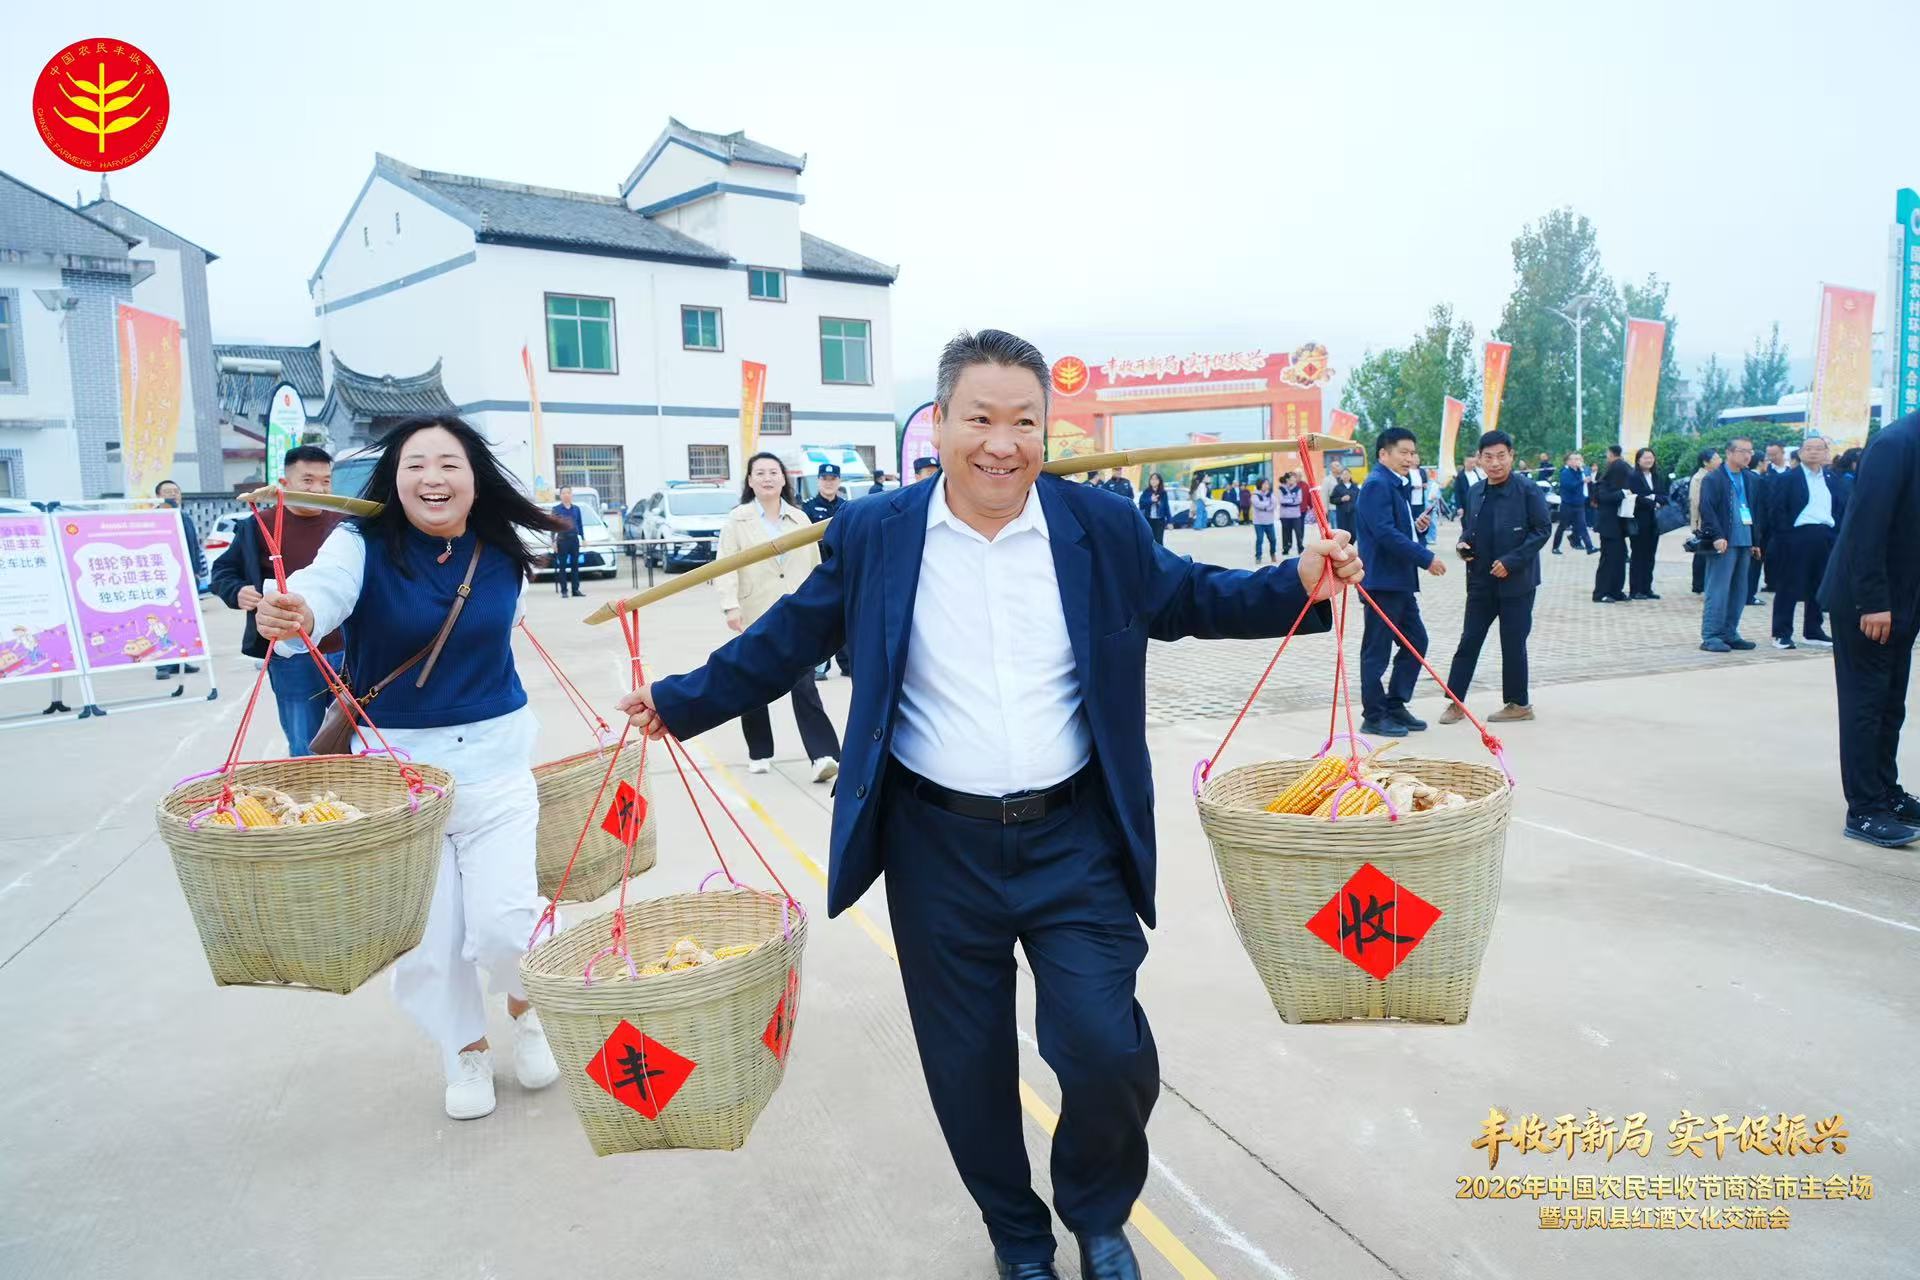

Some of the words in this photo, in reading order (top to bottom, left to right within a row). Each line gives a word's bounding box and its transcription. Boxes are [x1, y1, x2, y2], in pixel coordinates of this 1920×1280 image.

[0, 538, 41, 551] 迎丰年
[91, 569, 168, 587] 齐心迎丰年
[98, 588, 168, 604] 独轮车比赛
[1337, 892, 1416, 956] 收
[614, 1043, 665, 1101] 丰
